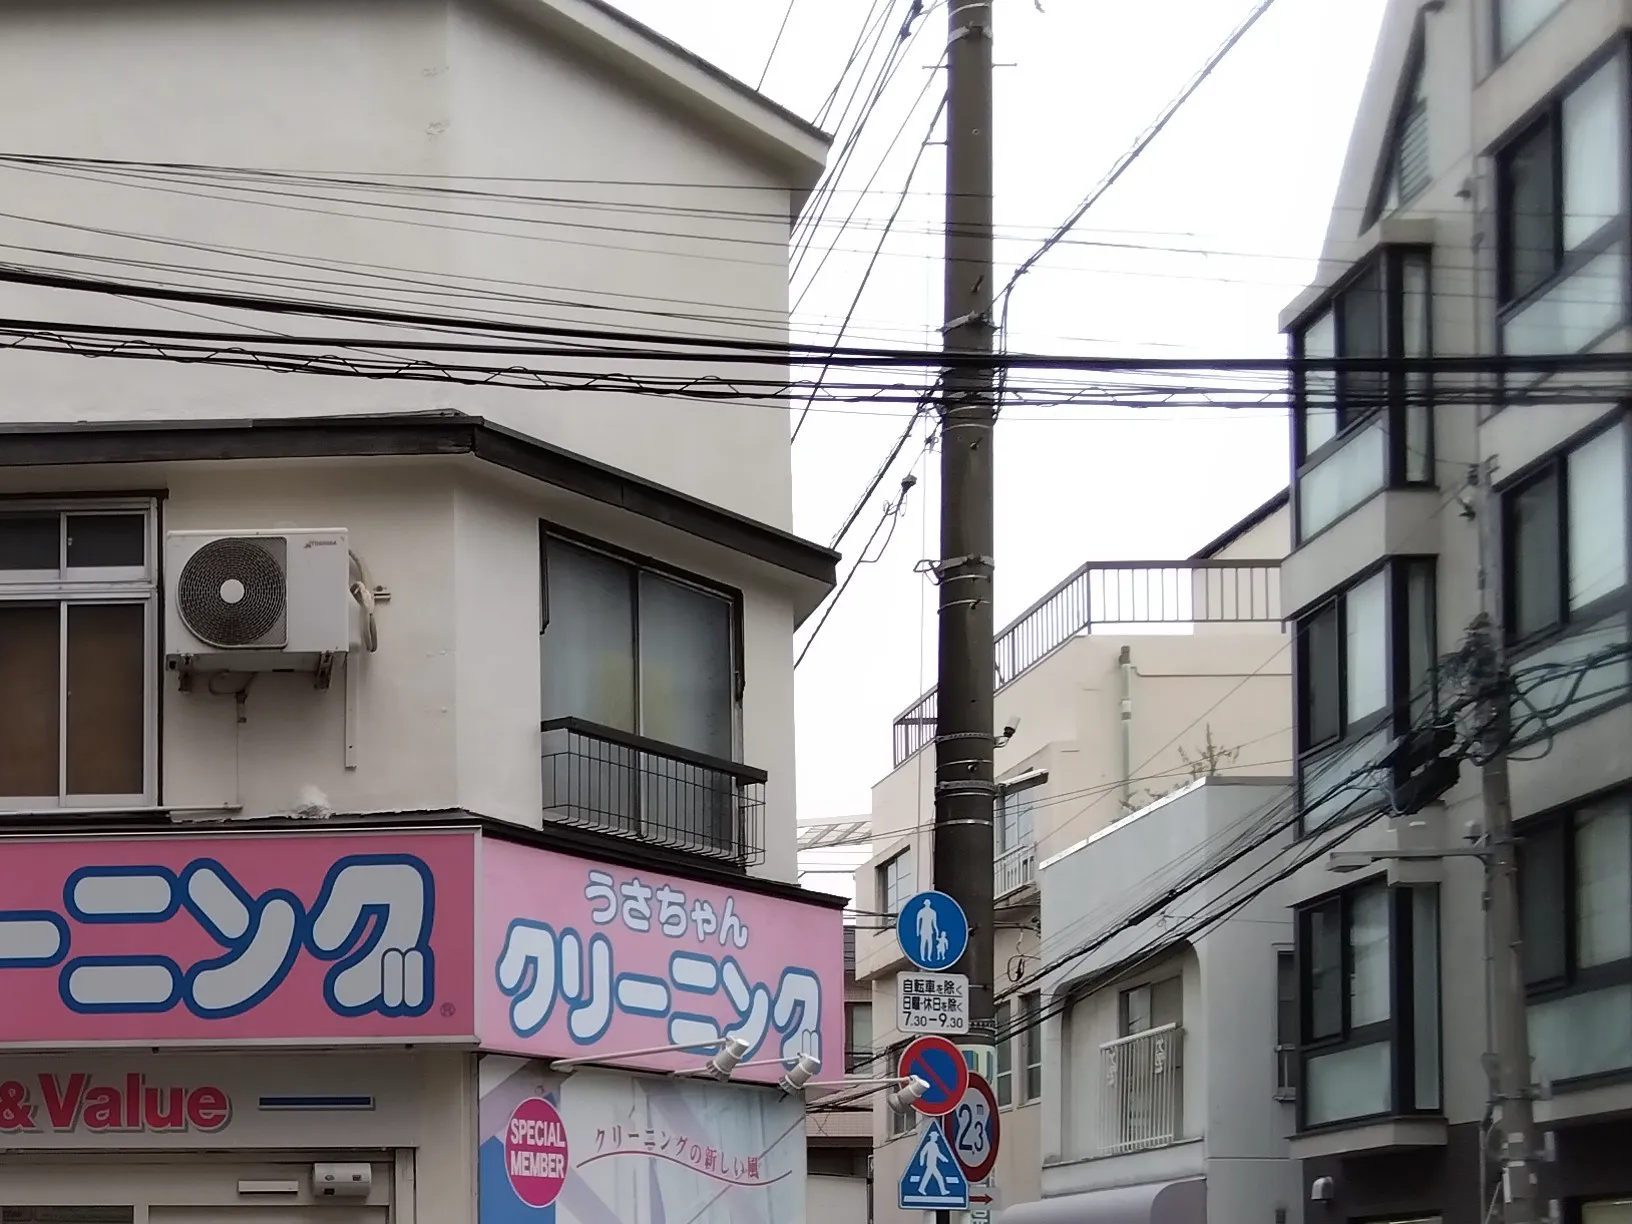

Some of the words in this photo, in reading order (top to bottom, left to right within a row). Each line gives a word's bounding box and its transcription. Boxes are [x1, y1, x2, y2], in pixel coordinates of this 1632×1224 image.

[584, 870, 750, 948] うさちゃん
[495, 918, 822, 1074] クリーニング
[903, 979, 962, 995] 自転車を除く
[510, 1118, 566, 1148] SPECIAL
[594, 1124, 761, 1180] クリーニングの新しい風
[510, 1151, 565, 1179] MEMBER
